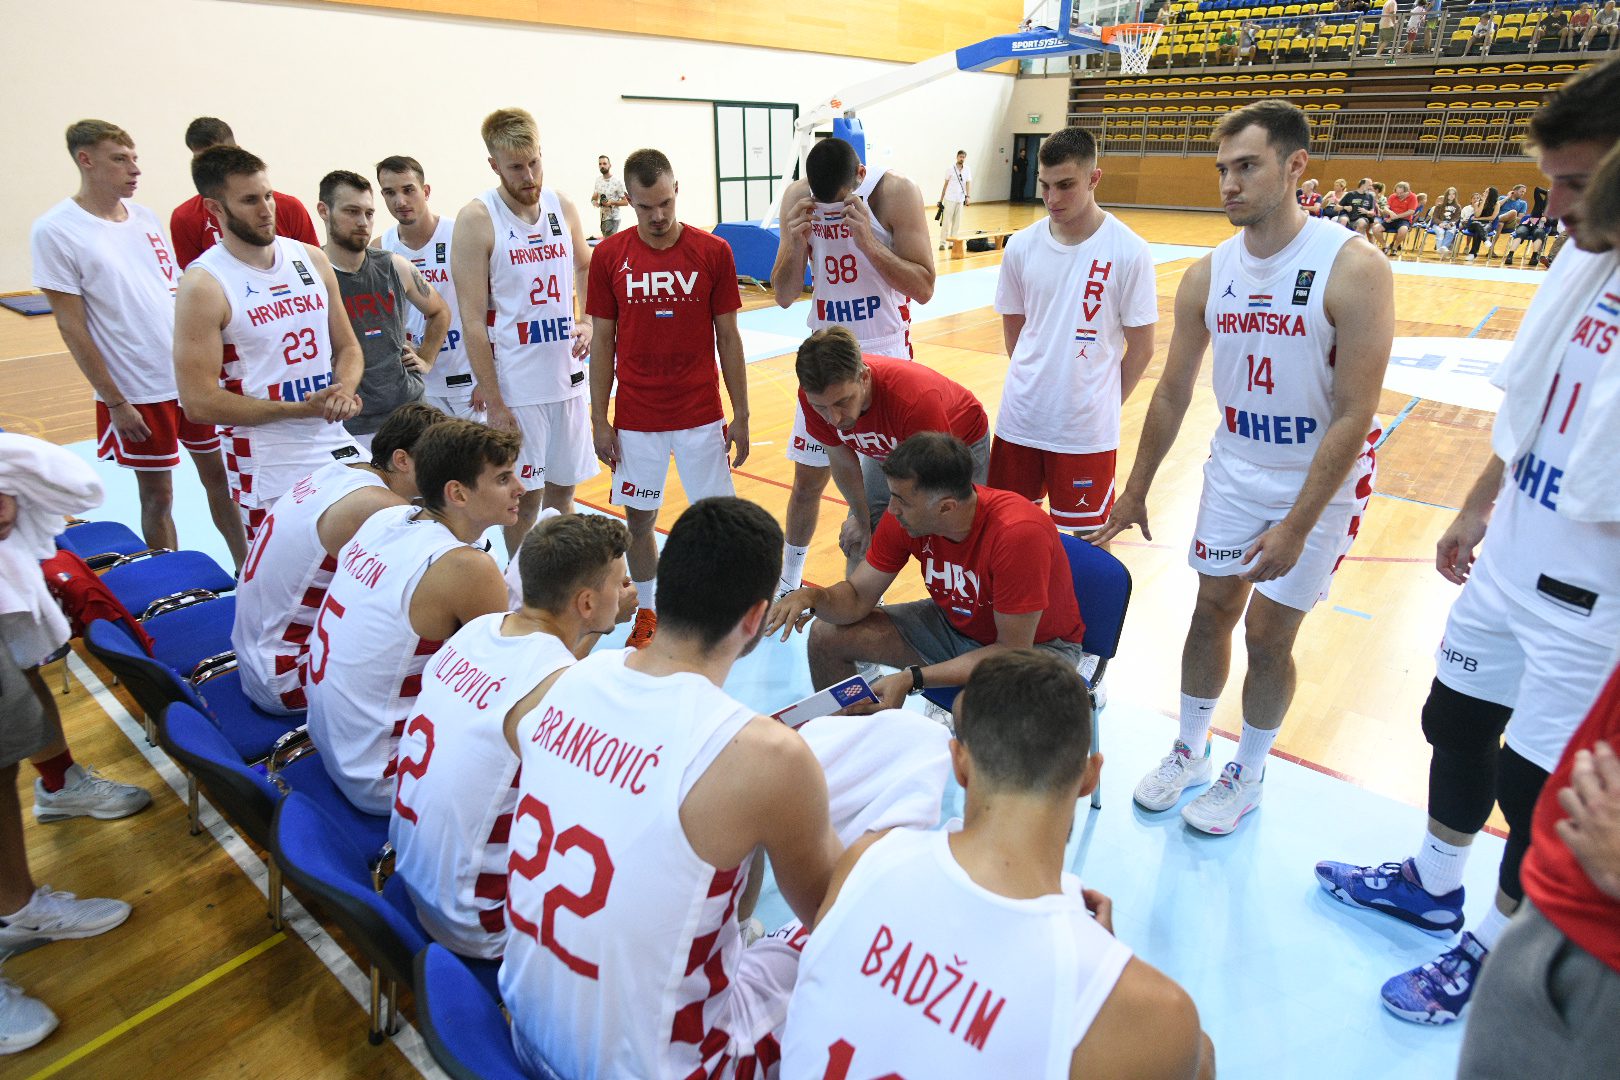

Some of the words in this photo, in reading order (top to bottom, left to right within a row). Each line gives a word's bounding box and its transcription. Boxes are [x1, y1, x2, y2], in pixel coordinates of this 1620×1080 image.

[145, 233, 173, 282] HRV
[510, 243, 567, 265] HRVATSKA
[825, 253, 858, 285] 98
[530, 274, 561, 306] 24
[626, 270, 699, 298] HRV
[1082, 259, 1112, 322] HRV
[247, 294, 325, 327] HRVATSKA
[541, 316, 572, 343] HE
[1216, 312, 1307, 337] HRVATSKA
[282, 327, 319, 366] 23
[1247, 354, 1275, 395] 14
[636, 488, 661, 499] HPB
[1518, 452, 1564, 512] HE
[1208, 548, 1242, 561] HPB
[925, 557, 981, 600] HRV
[310, 594, 346, 686] 5
[531, 705, 665, 796] BRANKOVIĆ
[507, 792, 616, 982] 22
[860, 923, 1007, 1053] BADŽIM
